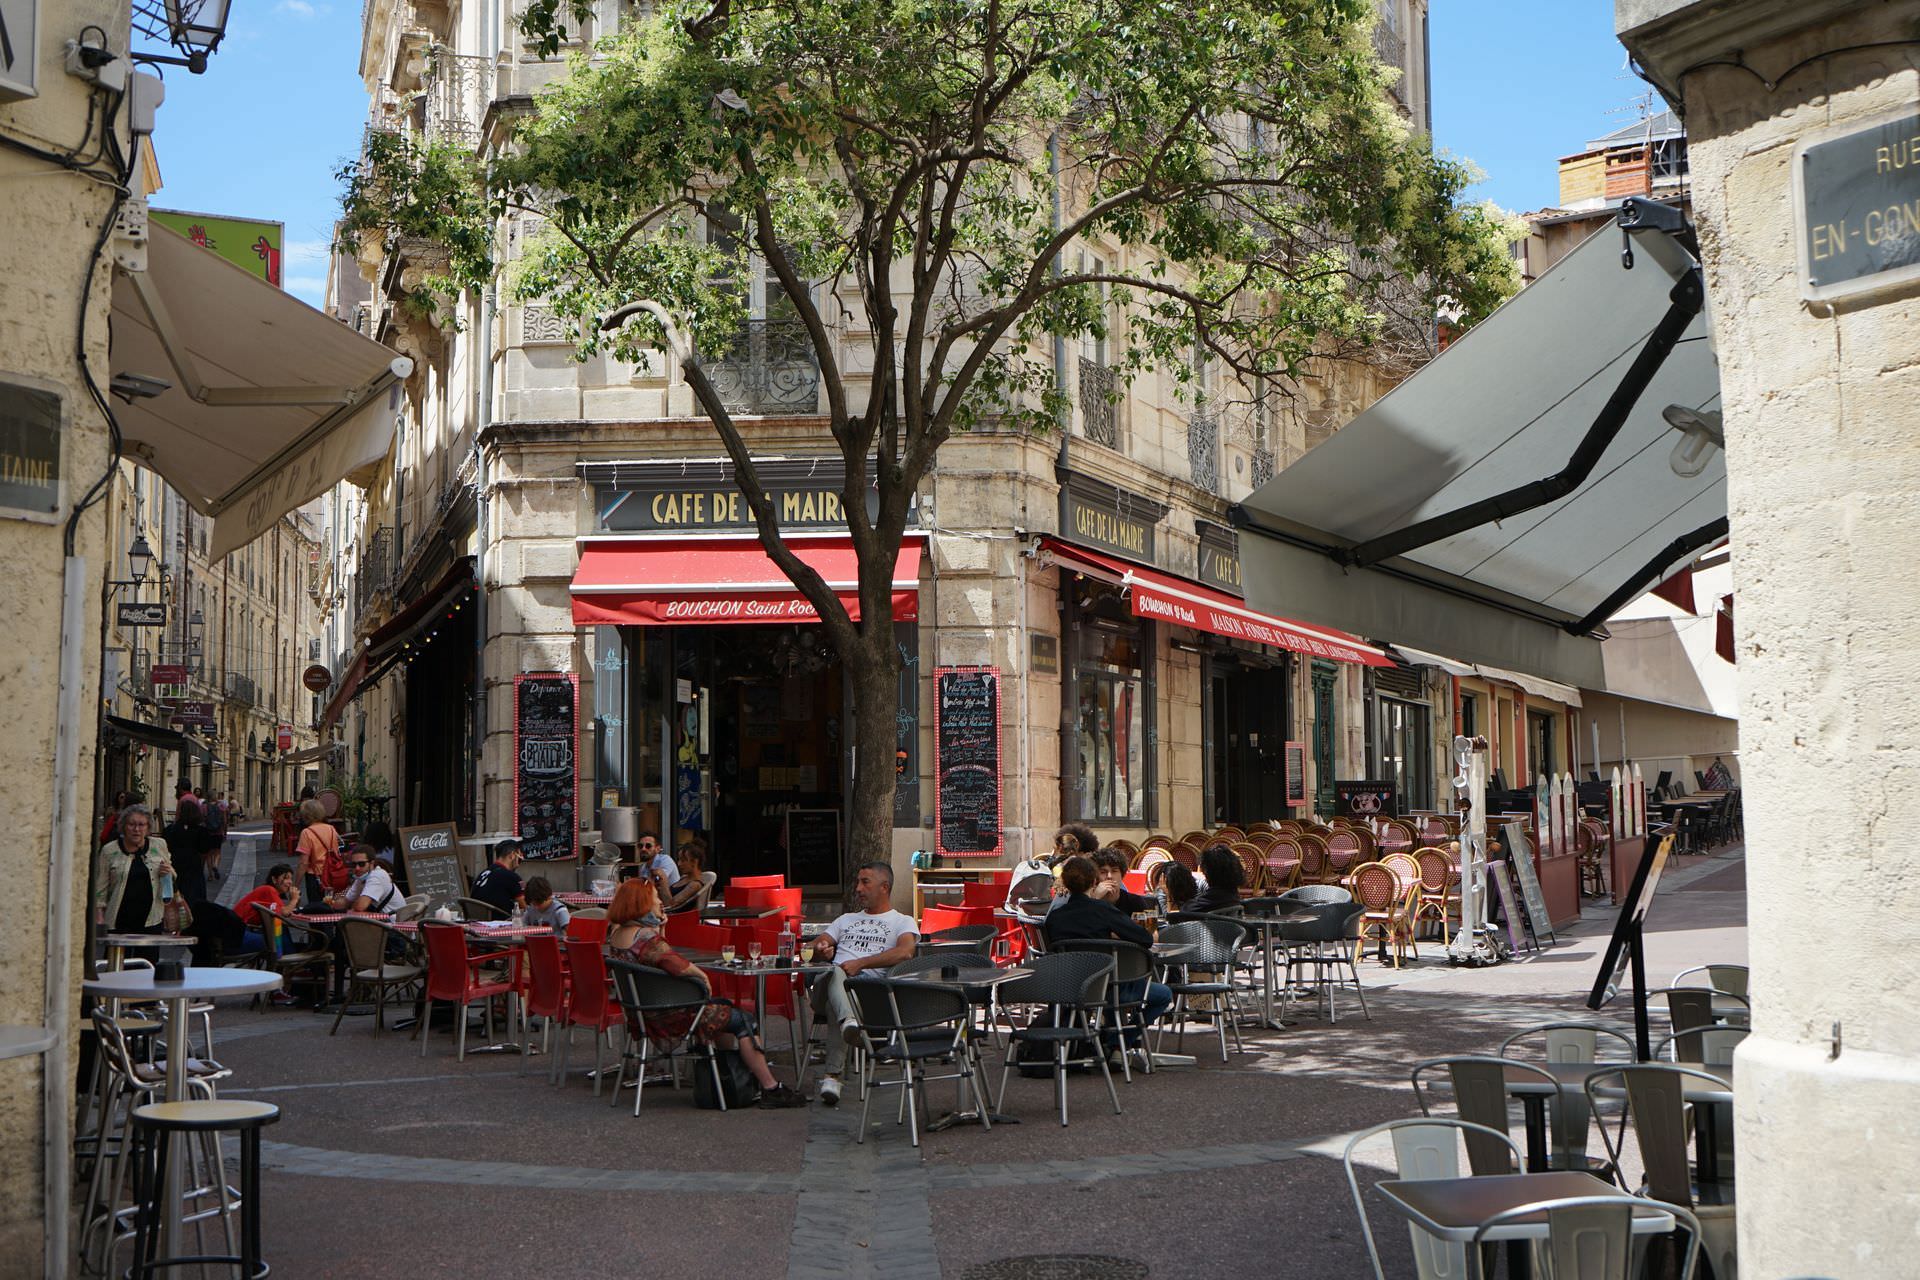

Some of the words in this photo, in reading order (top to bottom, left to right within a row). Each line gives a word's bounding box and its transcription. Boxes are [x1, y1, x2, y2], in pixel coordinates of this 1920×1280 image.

[1876, 137, 1920, 174] RUE
[651, 492, 705, 524] CAFE
[712, 492, 740, 523] DE
[783, 491, 848, 522] MAIR
[1076, 505, 1096, 537] CAFE
[1097, 511, 1107, 542] DE
[1108, 516, 1118, 545] LA
[1119, 520, 1144, 554] MAIRIE
[1215, 554, 1232, 584] CAFE
[666, 601, 744, 616] BOUCHON
[745, 600, 784, 615] Saint
[1139, 595, 1174, 617] BOUCHON
[1210, 612, 1244, 635] MAISON
[856, 935, 887, 943] FRANCISCO
